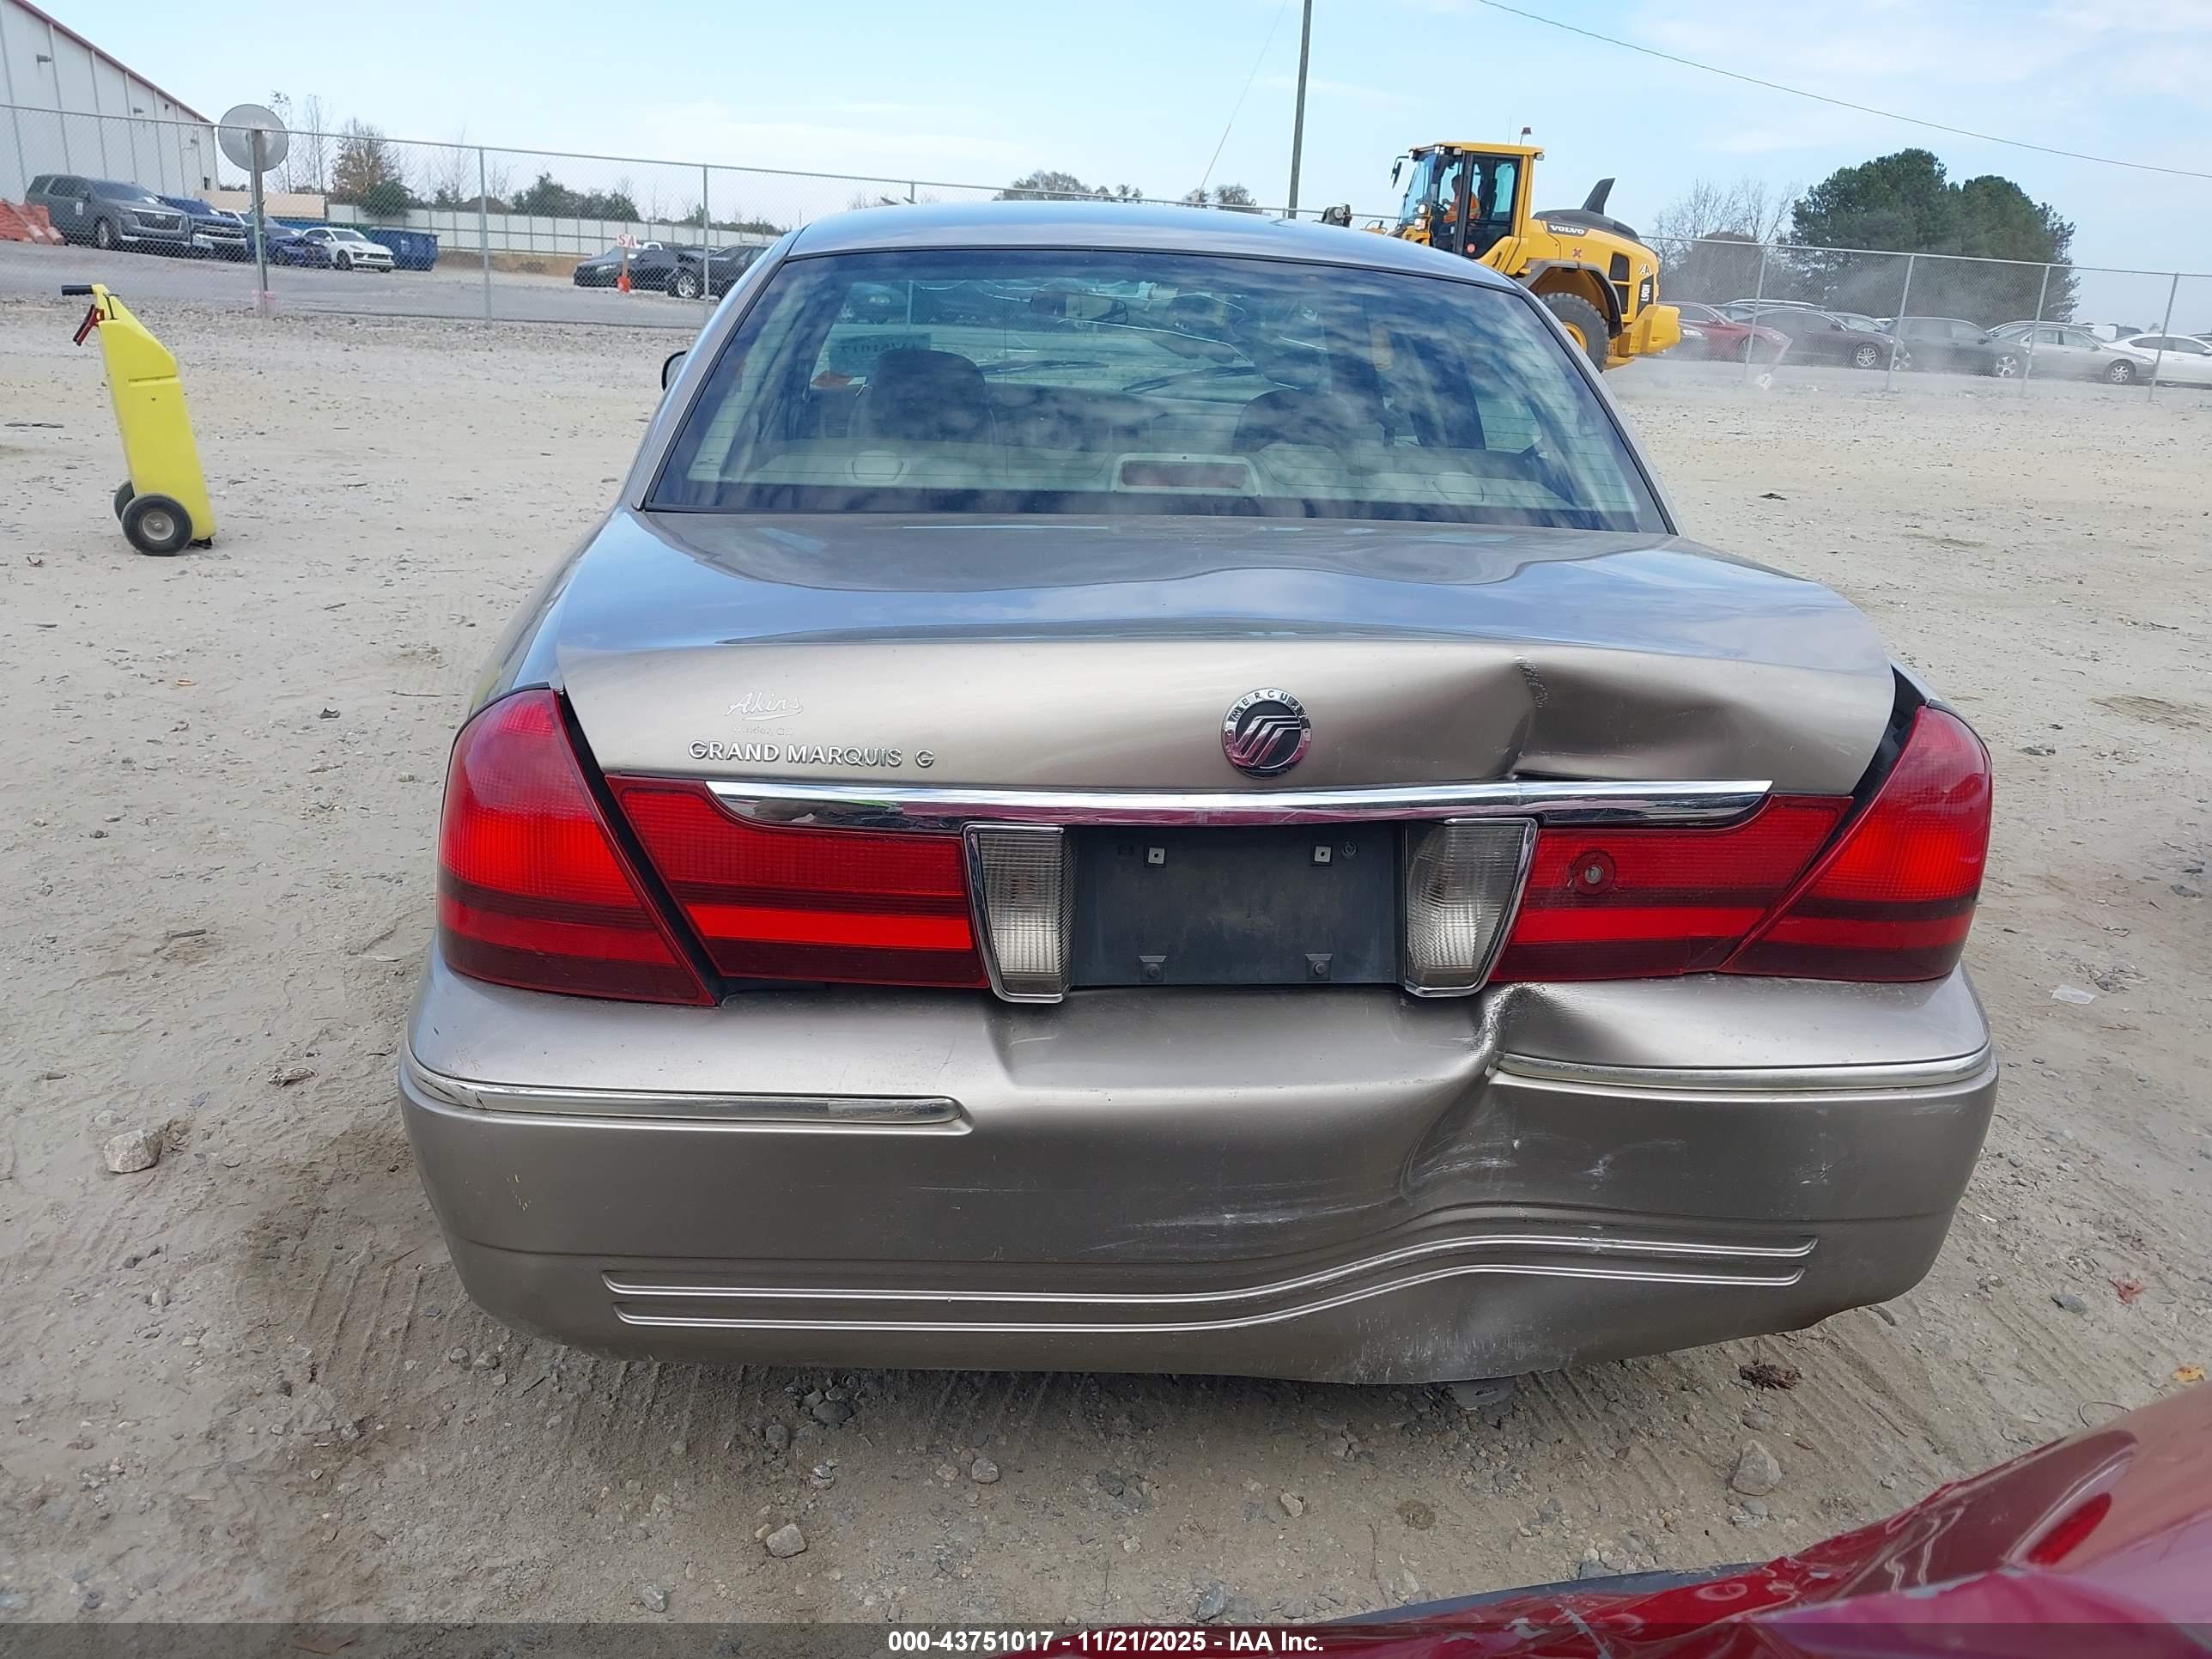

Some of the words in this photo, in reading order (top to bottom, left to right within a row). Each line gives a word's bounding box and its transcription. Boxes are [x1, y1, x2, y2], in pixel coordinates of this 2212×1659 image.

[1549, 225, 1585, 234] VOLVO
[725, 690, 804, 719] Akins
[1228, 690, 1309, 722] MERCURY
[688, 740, 780, 763] GRAND
[787, 744, 902, 768] MARQUIS
[915, 749, 935, 769] G
